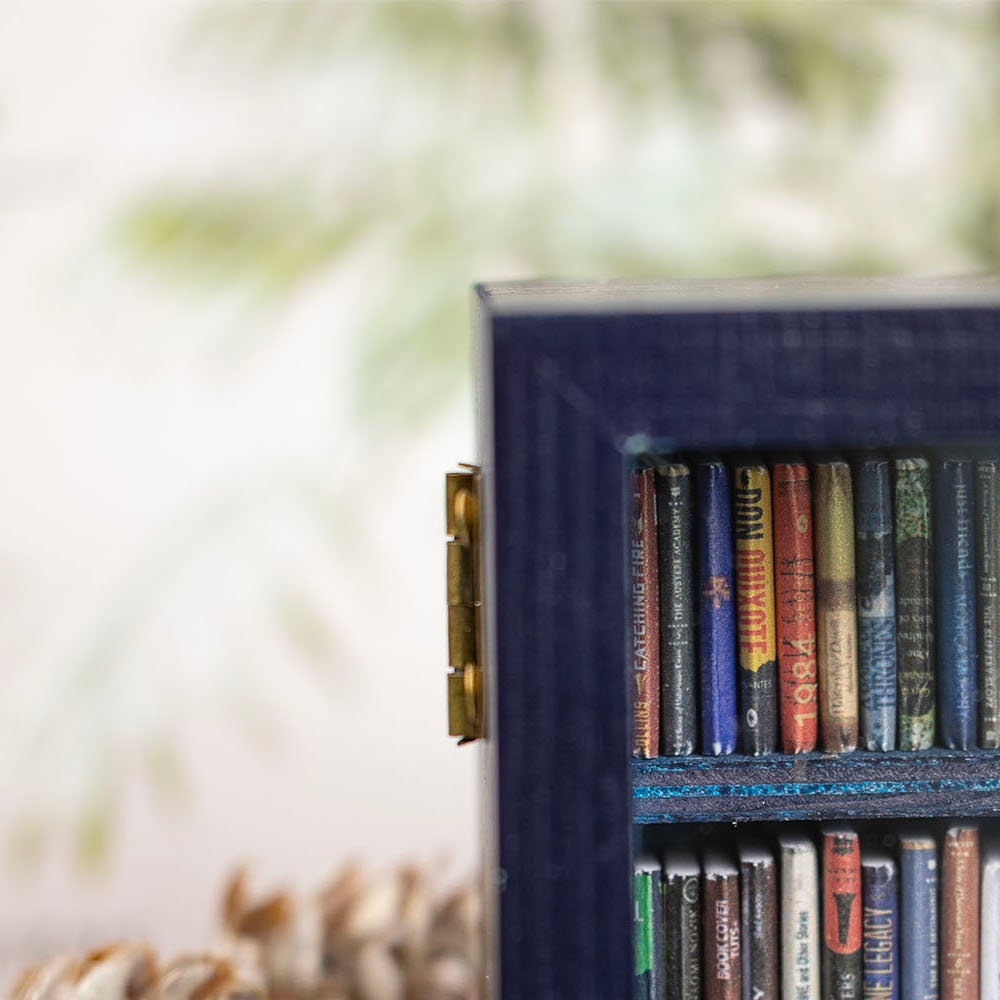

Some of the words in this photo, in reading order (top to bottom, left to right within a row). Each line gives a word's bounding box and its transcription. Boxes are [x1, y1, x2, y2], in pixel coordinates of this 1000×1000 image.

[671, 509, 681, 555] ACADEMY
[735, 488, 764, 539] DON
[632, 540, 645, 577] FIRE
[672, 558, 683, 600] AUSTERE
[673, 603, 683, 621] THE
[736, 550, 767, 654] QUIXOTE
[633, 583, 647, 670] CATCHING
[789, 632, 817, 727] 1984
[871, 622, 896, 711] THRONES
[716, 899, 730, 942] COVER
[795, 911, 809, 939] Stories
[928, 888, 937, 943] BEGINNING
[796, 942, 809, 965] Other
[862, 906, 893, 974] LEGACY
[928, 947, 937, 966] BAD
[716, 944, 730, 980] BOOK
[797, 967, 809, 983] and
[928, 970, 937, 989] THE
[954, 978, 964, 996] THE
